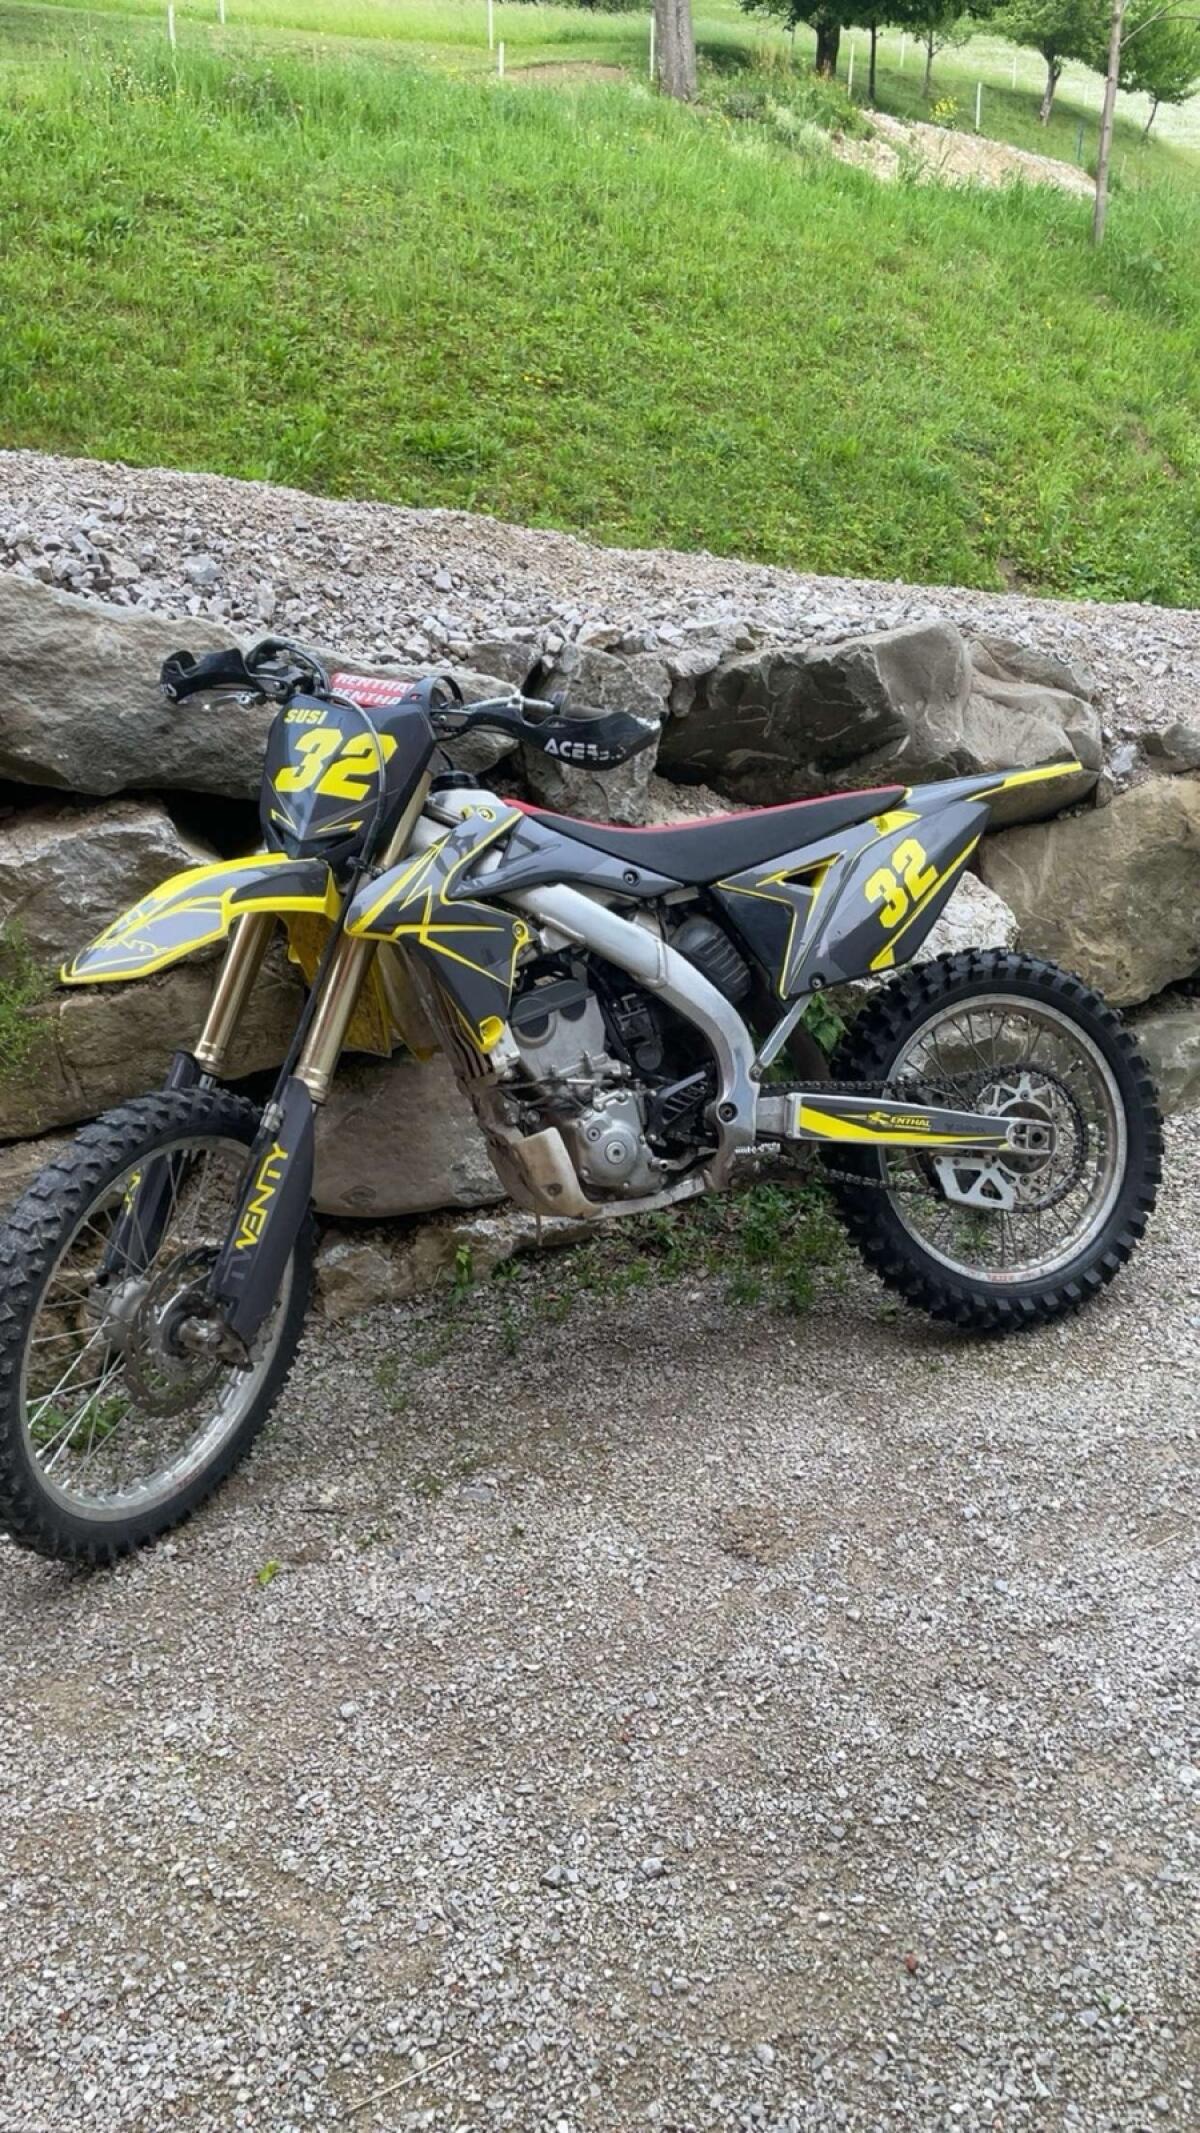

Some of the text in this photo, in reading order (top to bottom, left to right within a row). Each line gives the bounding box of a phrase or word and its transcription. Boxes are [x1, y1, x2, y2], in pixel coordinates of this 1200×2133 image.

[331, 687, 402, 705] RENTHA
[284, 708, 328, 724] SUSI
[544, 738, 626, 761] ACER
[275, 728, 398, 801] 32
[865, 838, 938, 928] 32
